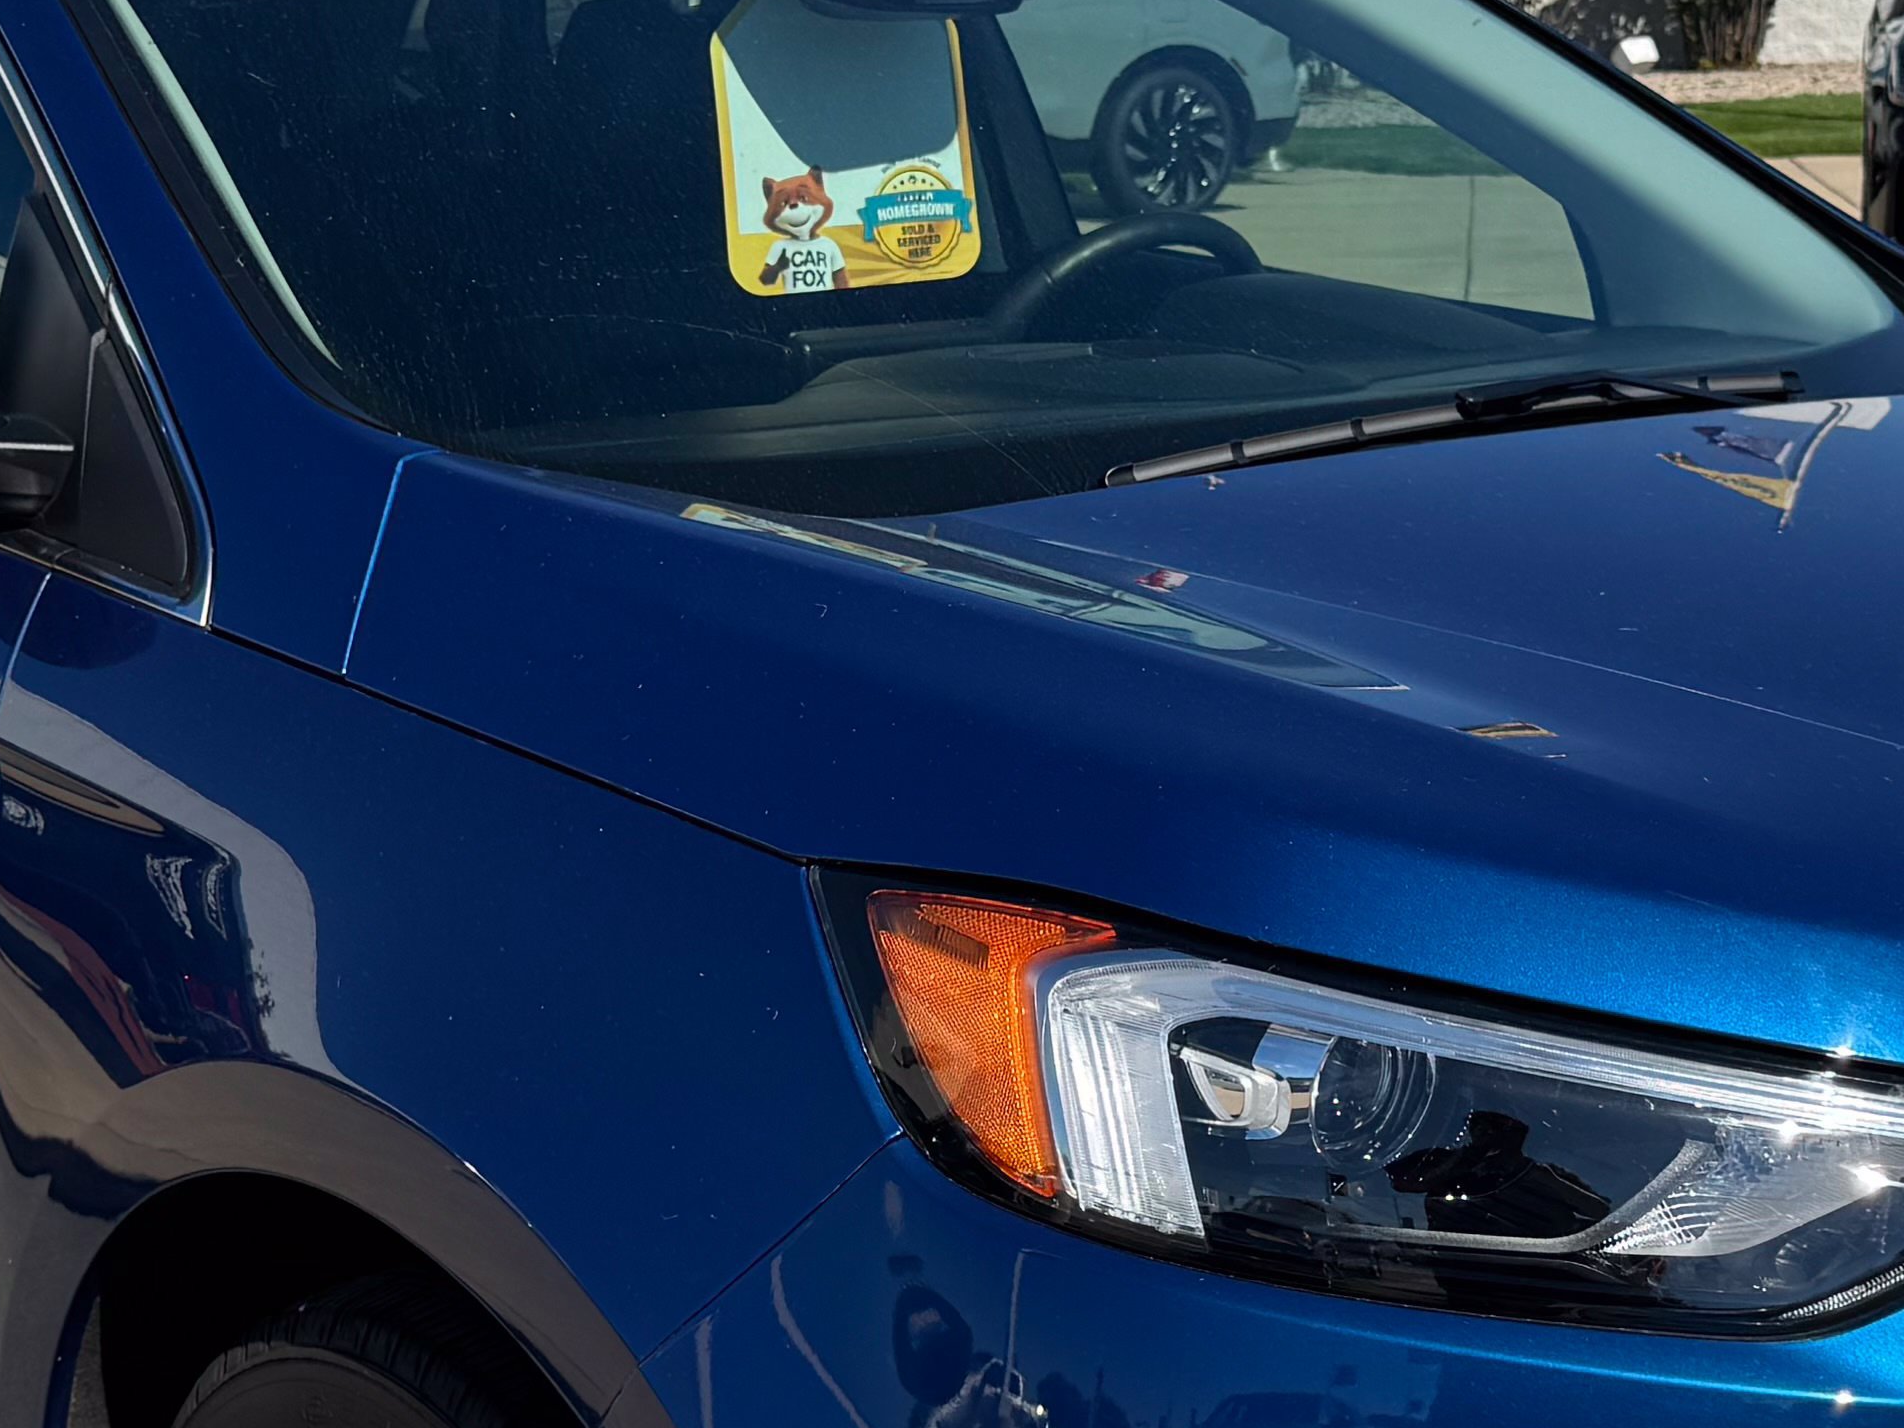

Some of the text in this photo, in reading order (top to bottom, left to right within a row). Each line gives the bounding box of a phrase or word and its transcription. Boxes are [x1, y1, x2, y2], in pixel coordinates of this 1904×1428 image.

[877, 203, 954, 222] HOMEGROWN
[901, 224, 925, 236] SOLD
[791, 249, 828, 268] CAR
[792, 269, 827, 289] FOX
